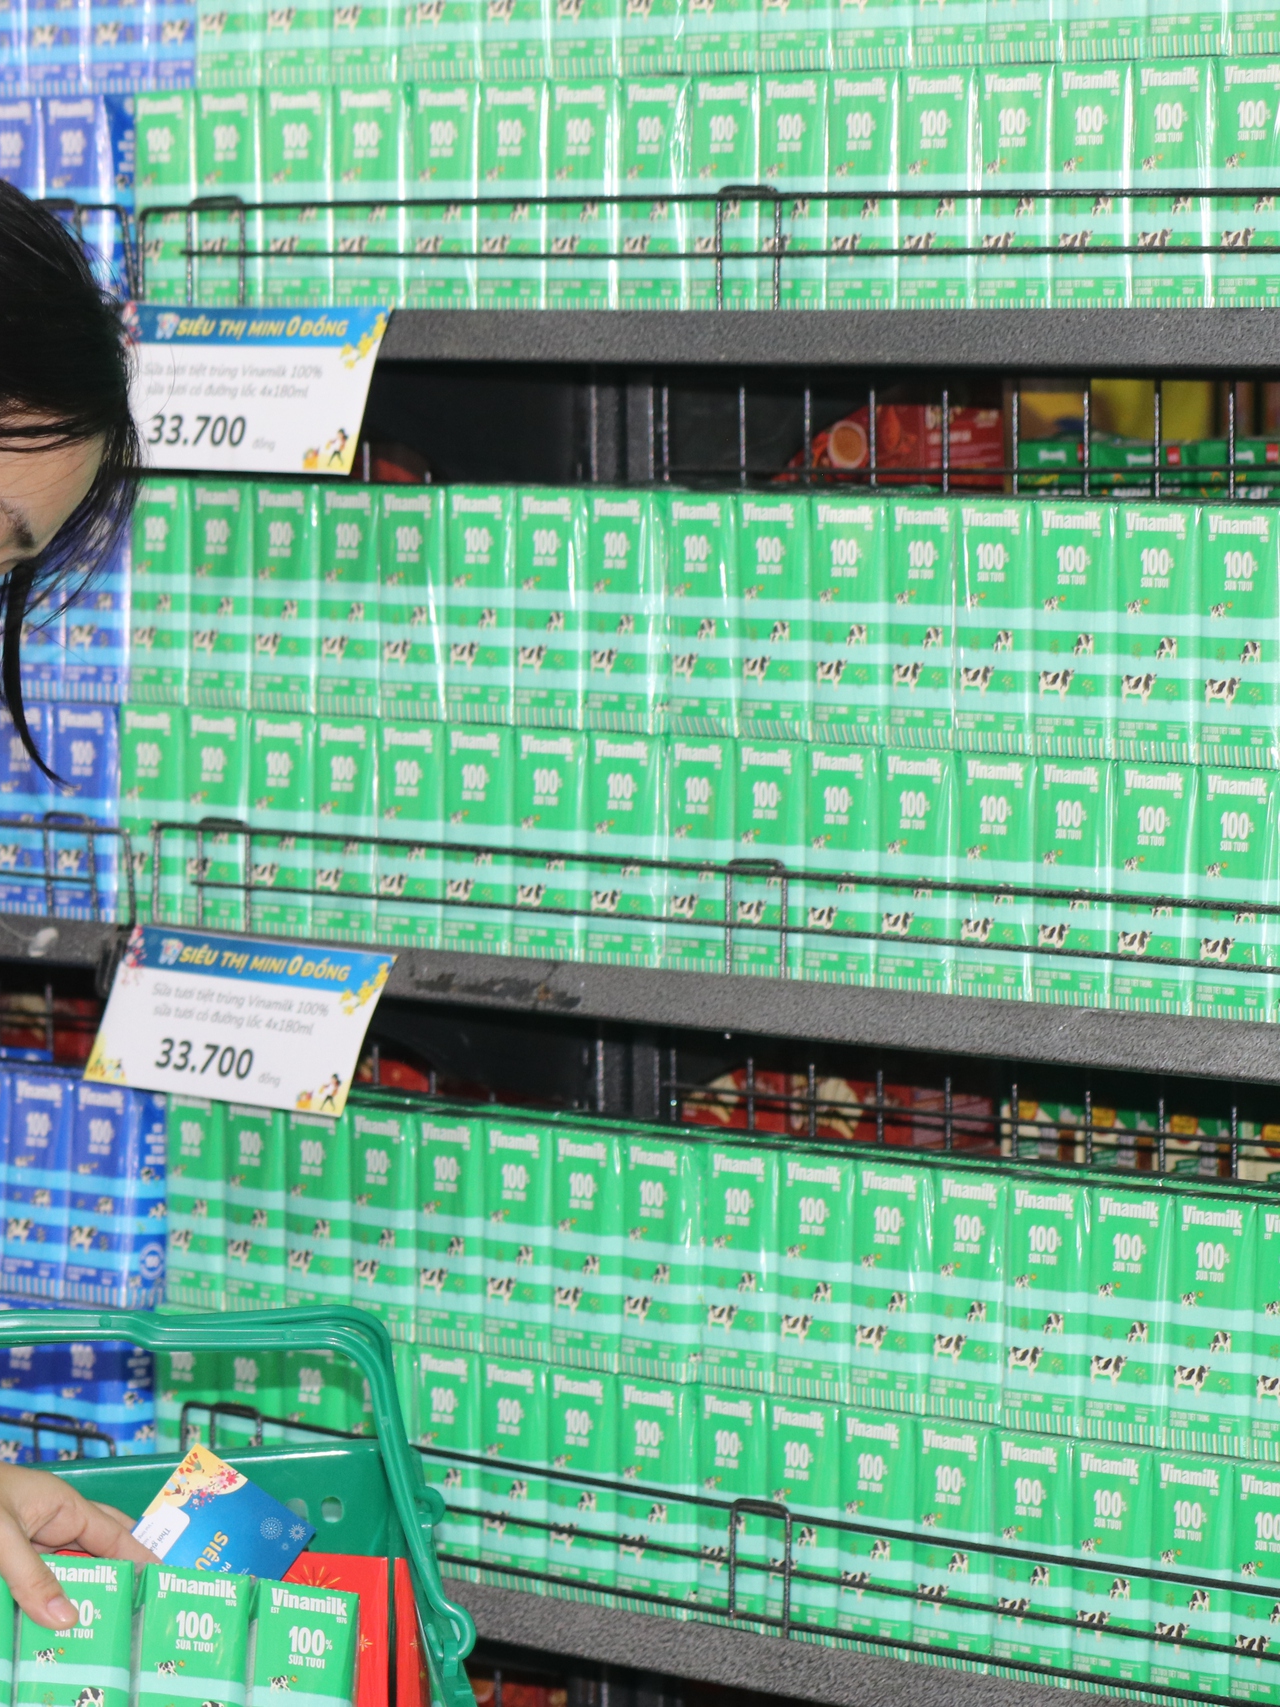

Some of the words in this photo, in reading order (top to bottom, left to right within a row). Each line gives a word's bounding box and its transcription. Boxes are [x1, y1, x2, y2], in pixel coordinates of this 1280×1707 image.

[834, 77, 887, 97] Vinamilk
[907, 75, 964, 95] Vinamilk
[984, 72, 1043, 94] Vinamilk
[1062, 70, 1121, 90] Vinamilk
[1141, 66, 1200, 87] Vinamilk
[766, 79, 817, 98] Vinamilk
[247, 320, 286, 337] MINI
[286, 316, 301, 337] 0
[147, 414, 247, 447] 33.700
[742, 502, 795, 522] Vinamilk
[817, 504, 874, 523] Vinamilk
[895, 505, 949, 524] Vinamilk
[962, 505, 1020, 526] Vinamilk
[1041, 510, 1101, 530] Vinamilk
[1126, 512, 1185, 532] Vinamilk
[1209, 515, 1269, 535] Vinamilk
[742, 747, 792, 767] Vinamilk
[812, 751, 864, 772] Vinamilk
[888, 755, 942, 776] Vinamilk
[967, 759, 1025, 781] Vinamilk
[1044, 764, 1100, 785] Vinamilk
[1125, 769, 1184, 792] Vinamilk
[1208, 775, 1267, 797] Vinamilk
[249, 955, 288, 974] MINI
[287, 955, 304, 976] 0
[248, 994, 294, 1012] Vinamilk
[155, 1038, 254, 1080] 33.700
[787, 1161, 842, 1185] Vinamilk
[862, 1170, 918, 1193] Vinamilk
[942, 1178, 998, 1200] Vinamilk
[1015, 1189, 1074, 1212] Vinamilk
[1099, 1196, 1159, 1220] Vinamilk
[1181, 1205, 1243, 1229] Vinamilk
[773, 1406, 825, 1430] Vinamilk
[846, 1417, 900, 1442] Vinamilk
[922, 1428, 978, 1454] Vinamilk
[1001, 1440, 1057, 1466] Vinamilk
[1080, 1452, 1139, 1477] Vinamilk
[1160, 1463, 1219, 1488] Vinamilk
[1241, 1474, 1280, 1497] Vinam
[45, 1562, 118, 1585] inamilk
[105, 1584, 118, 1592] 1976
[158, 1572, 237, 1600] Vinamilk
[225, 1599, 237, 1607] 1976
[270, 1606, 280, 1614] EST
[271, 1587, 348, 1617] Vinamilk
[176, 1610, 222, 1641] 100%
[336, 1616, 348, 1624] 1976
[288, 1625, 333, 1657] 100%
